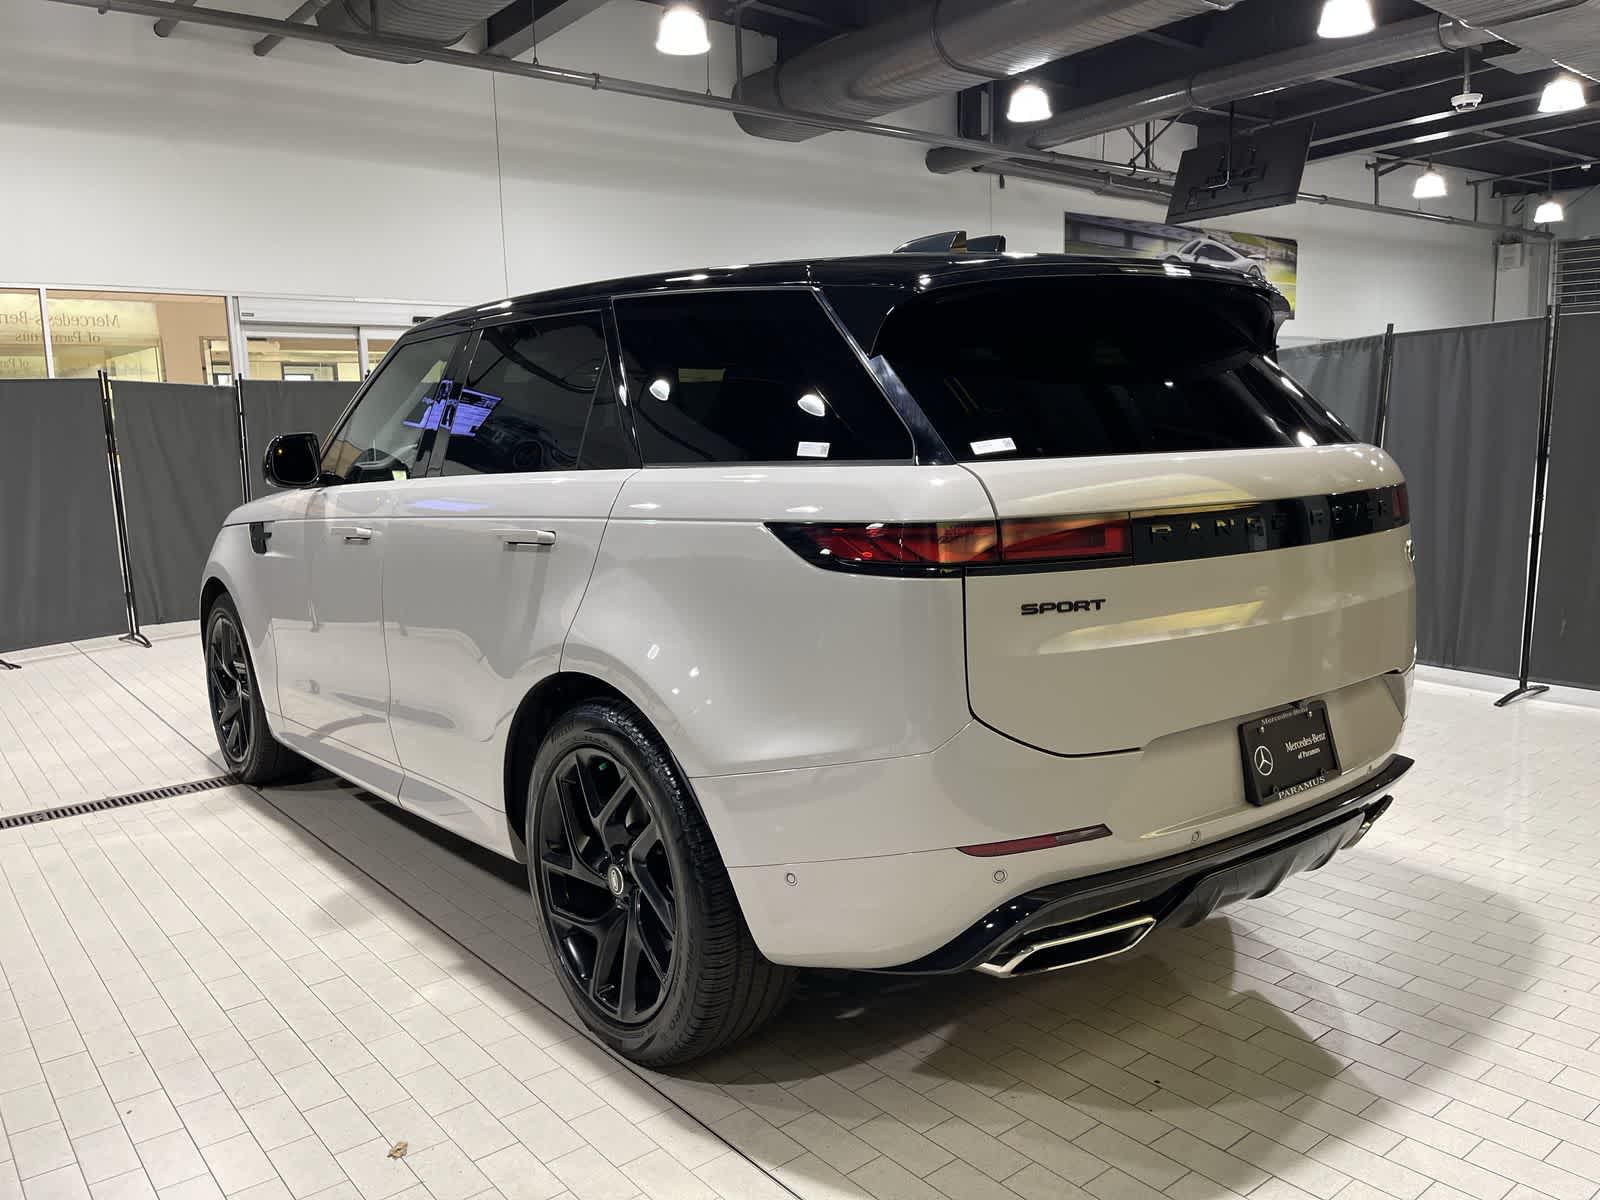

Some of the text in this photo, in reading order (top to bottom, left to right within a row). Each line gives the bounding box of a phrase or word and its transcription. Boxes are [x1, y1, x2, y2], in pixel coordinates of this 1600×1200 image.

[1020, 598, 1107, 616] SPORT
[1284, 732, 1327, 752] Mercedes-Benz
[1278, 775, 1326, 800] PARAMUS
